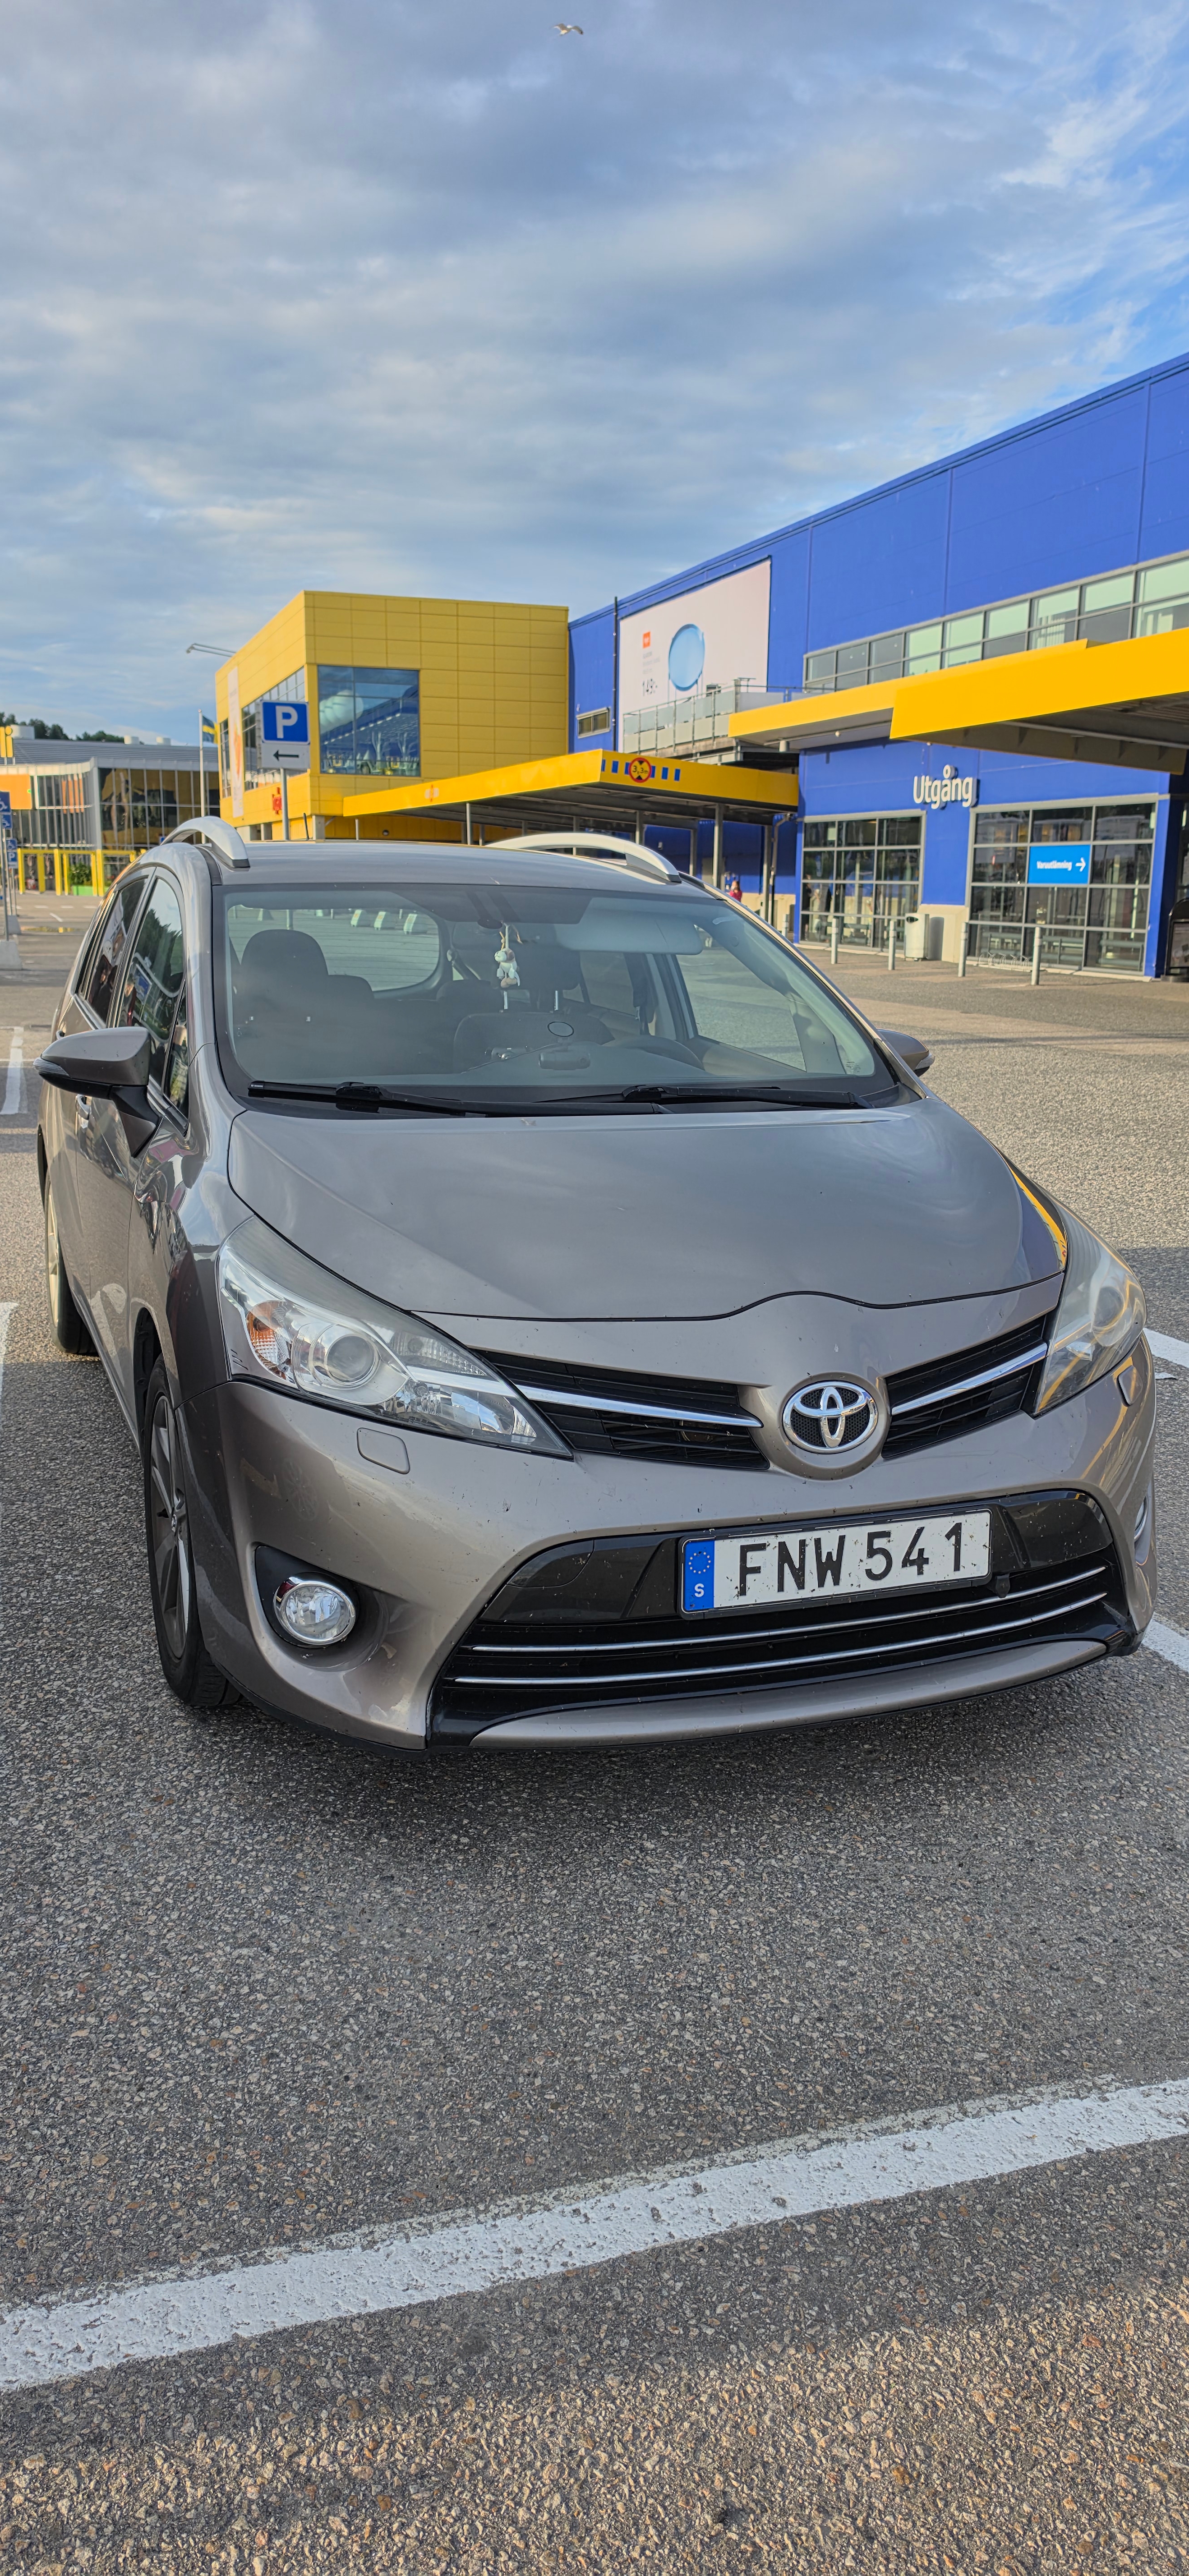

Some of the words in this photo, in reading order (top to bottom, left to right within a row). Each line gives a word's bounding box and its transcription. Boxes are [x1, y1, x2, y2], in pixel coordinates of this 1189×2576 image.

[276, 705, 298, 739] P
[913, 764, 973, 810] Utgång
[9, 852, 15, 861] P
[739, 1535, 846, 1596] FNW
[865, 1523, 962, 1581] 541
[694, 1583, 705, 1598] S
